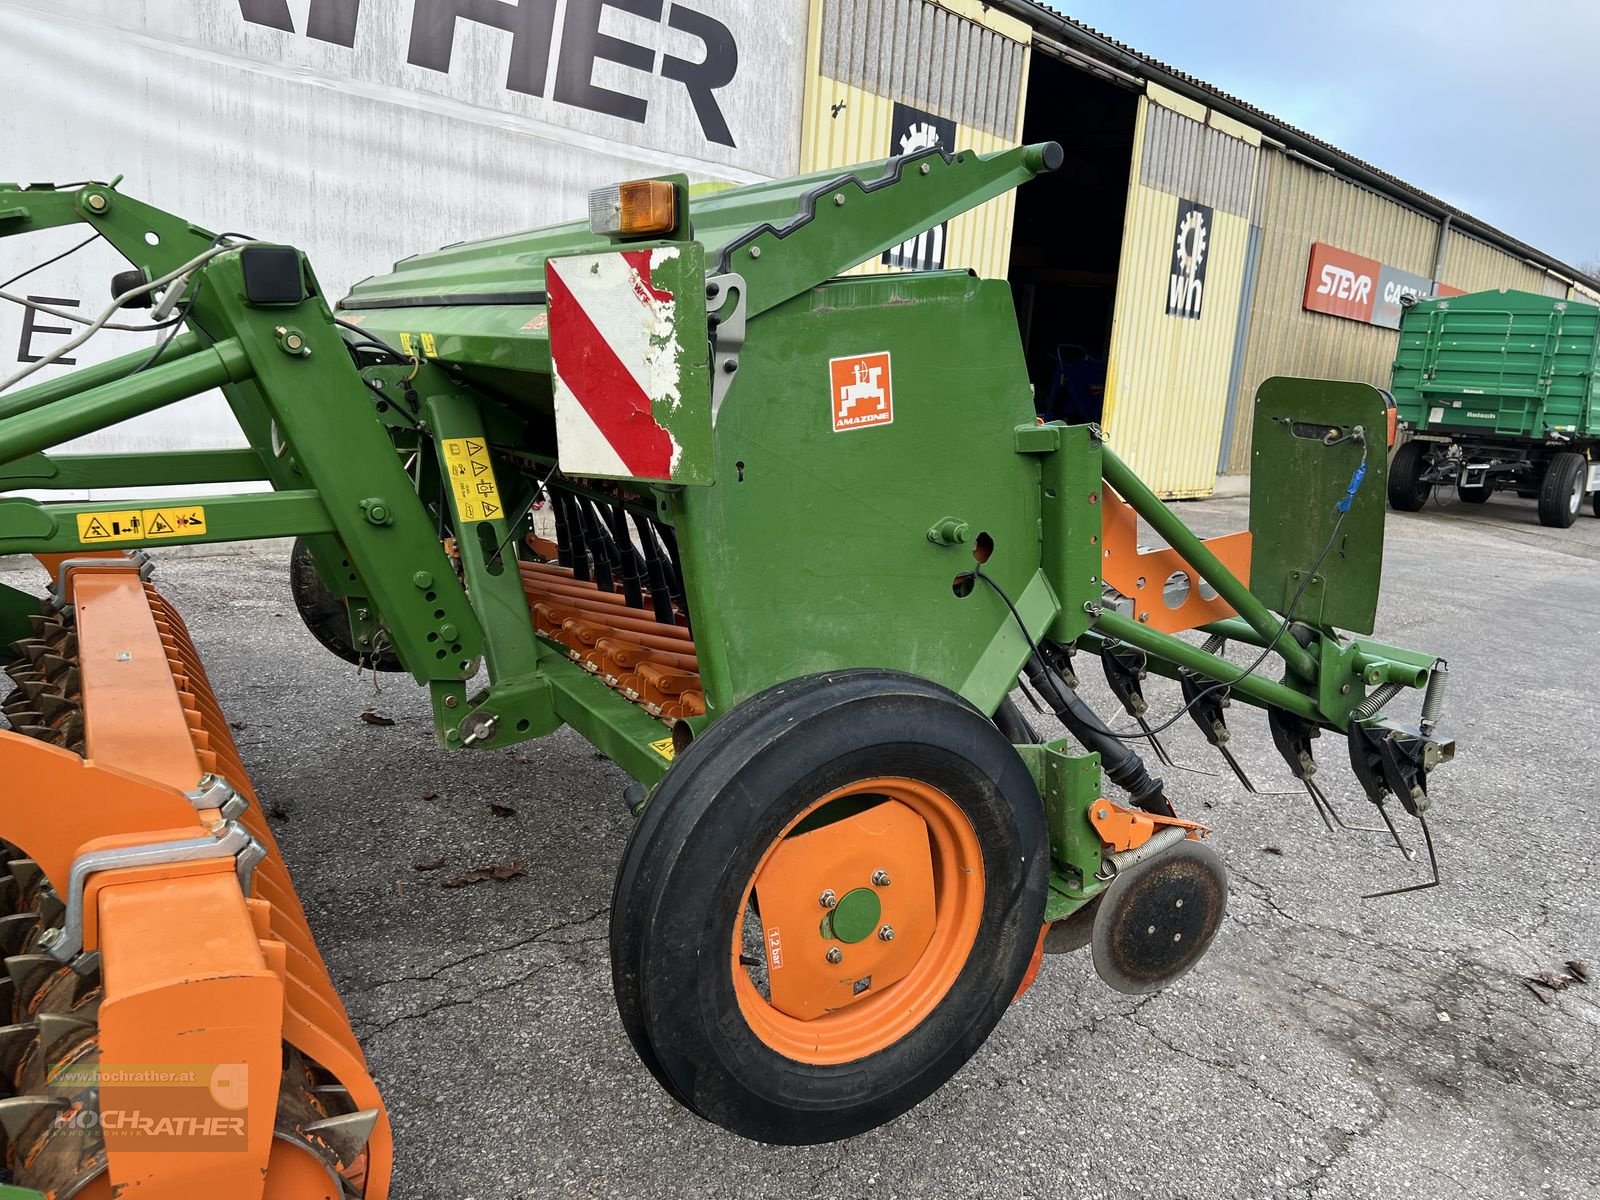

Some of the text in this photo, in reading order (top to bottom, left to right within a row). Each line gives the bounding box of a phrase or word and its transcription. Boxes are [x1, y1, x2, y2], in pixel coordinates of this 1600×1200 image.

[1316, 264, 1372, 305] STEYR
[17, 295, 80, 365] E
[836, 412, 890, 427] AMAZONE
[772, 948, 781, 965] bar
